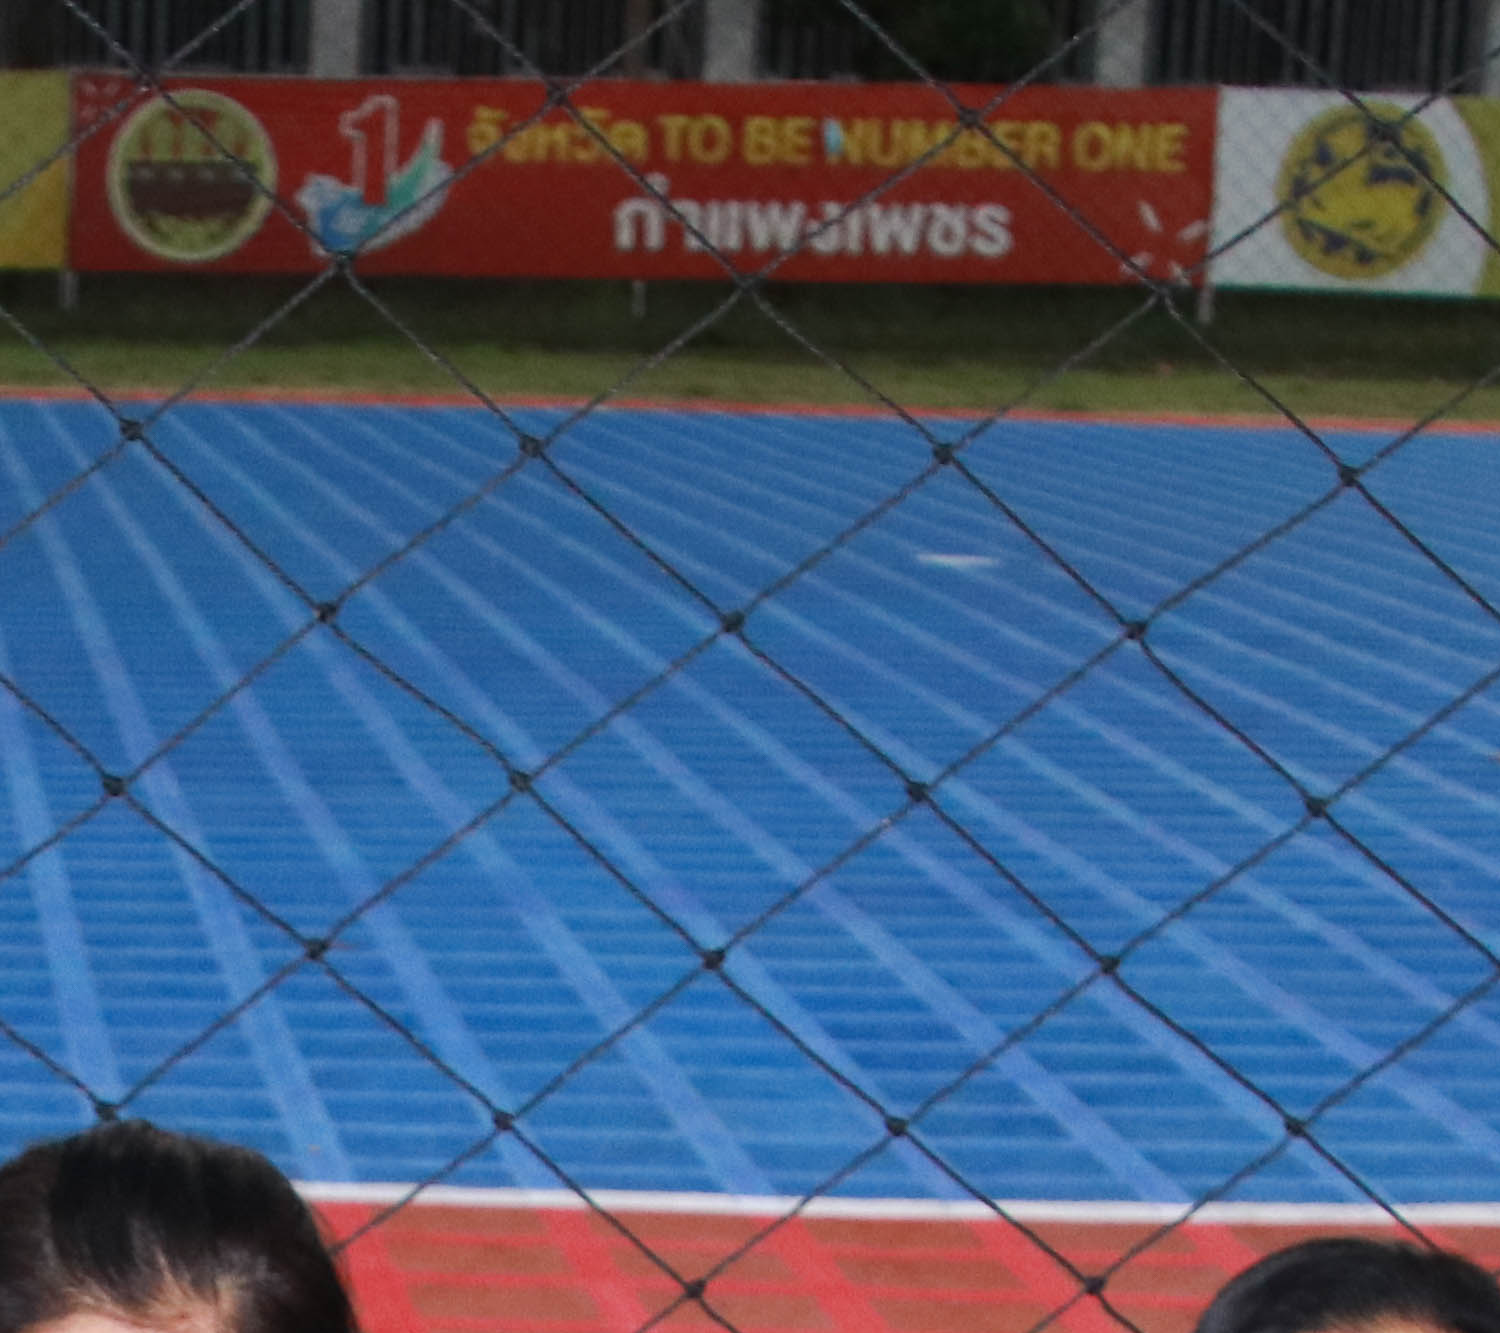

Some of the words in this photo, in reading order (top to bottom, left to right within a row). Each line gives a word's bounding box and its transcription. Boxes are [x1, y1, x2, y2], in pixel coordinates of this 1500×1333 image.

[659, 114, 732, 164] TO
[743, 116, 814, 167] BE
[821, 117, 1062, 169] NUMBER
[1073, 121, 1189, 173] ONE
[613, 172, 1016, 258] กำแพงเพชร
